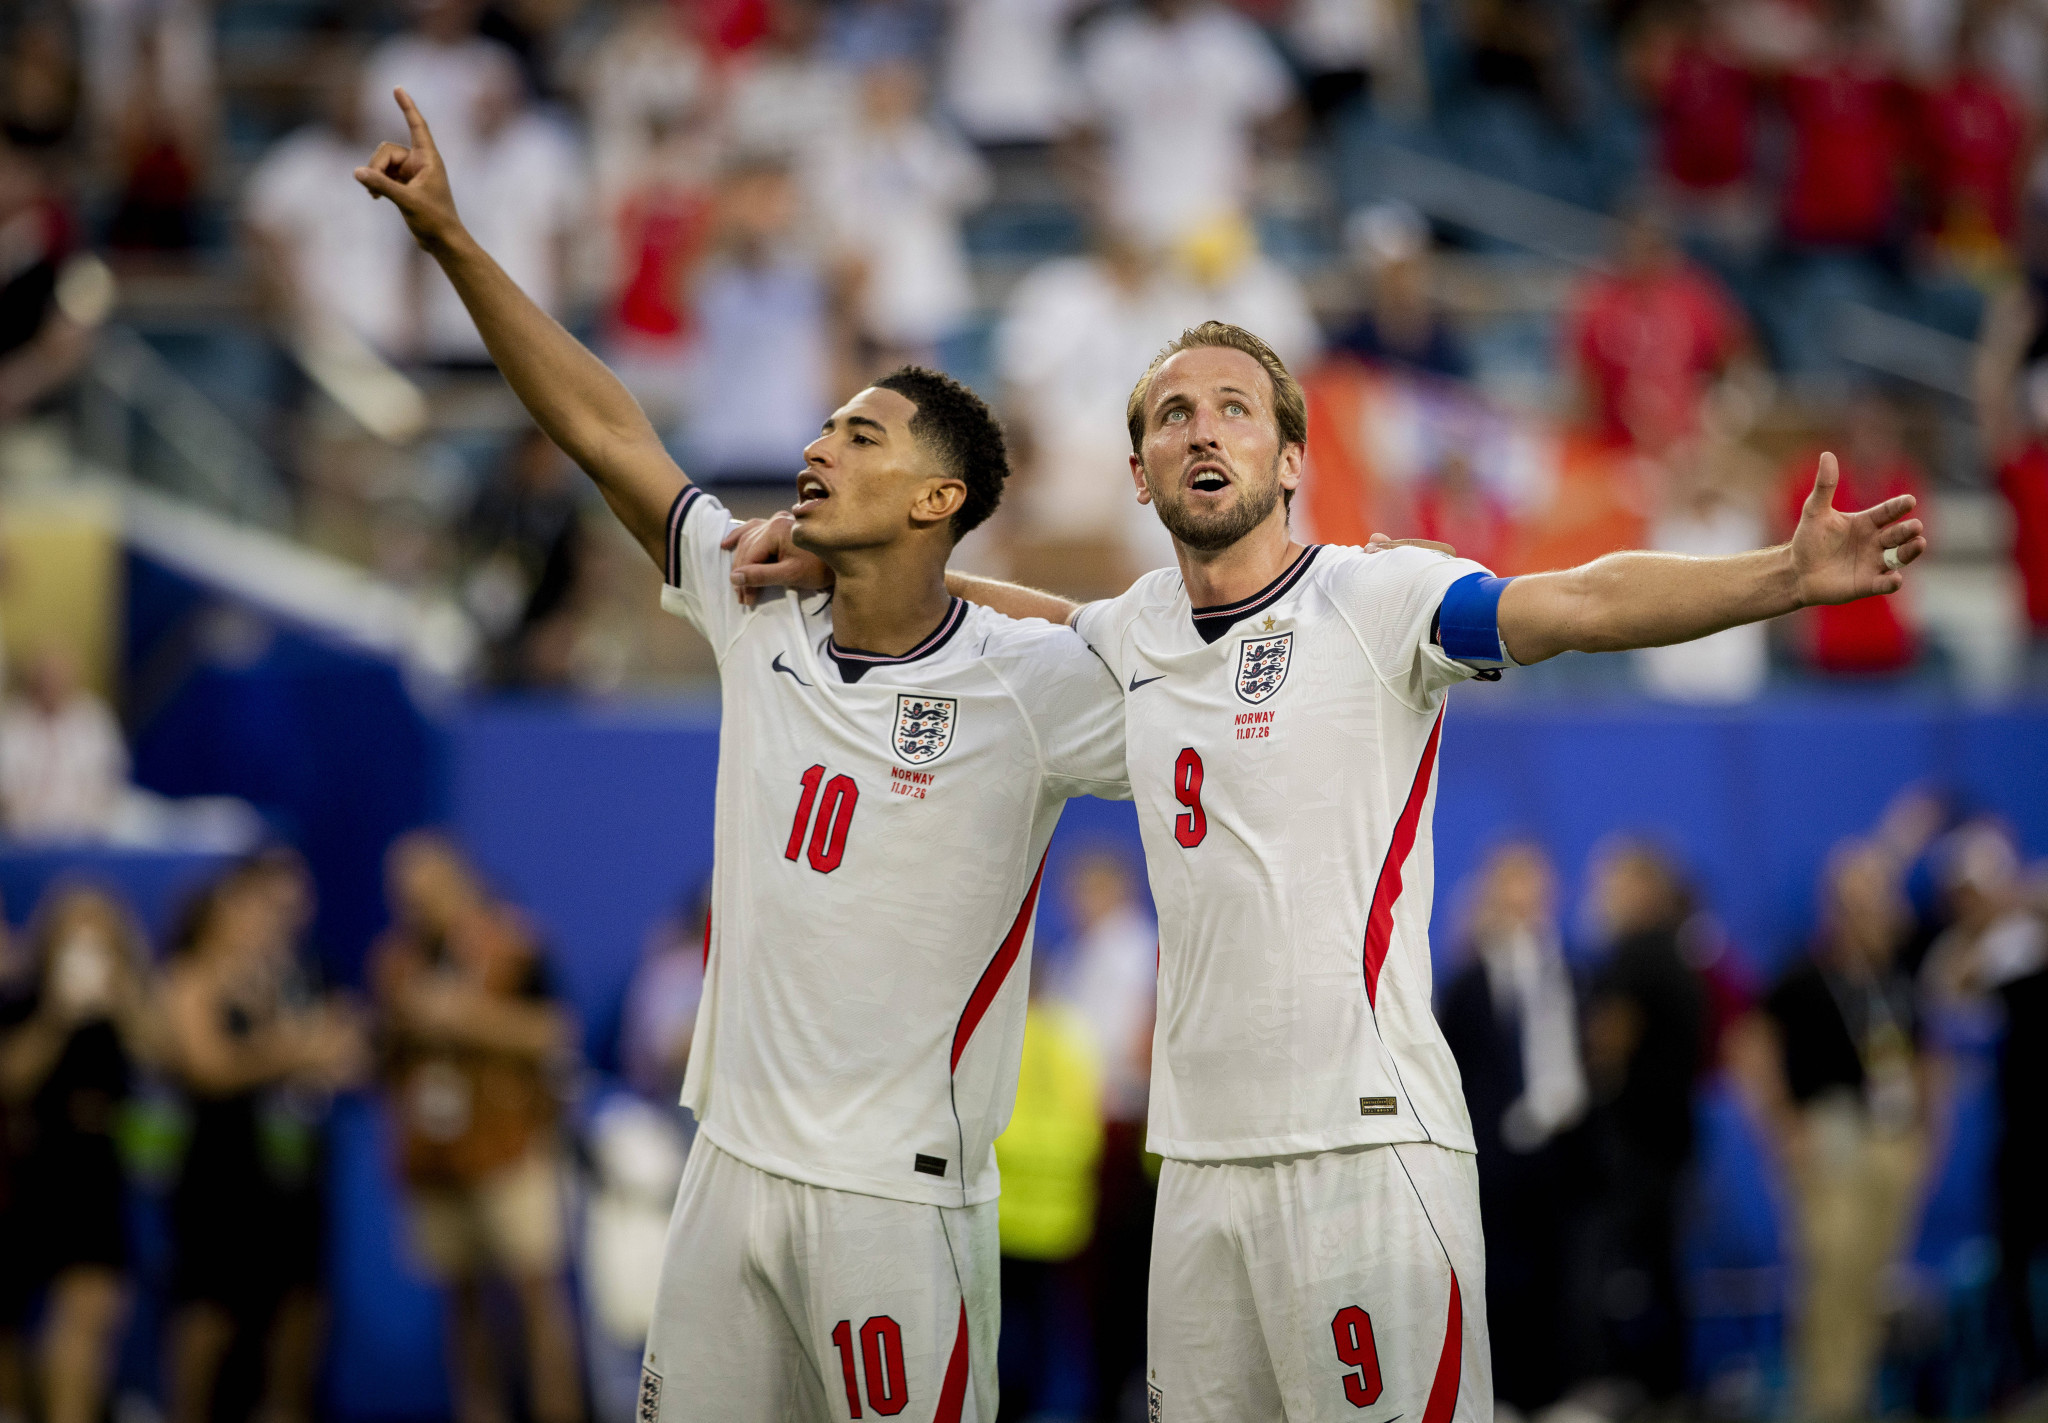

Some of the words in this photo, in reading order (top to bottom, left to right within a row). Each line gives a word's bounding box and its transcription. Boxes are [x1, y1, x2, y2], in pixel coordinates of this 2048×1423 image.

[1234, 711, 1275, 726] NORWAY
[1236, 726, 1270, 740] 11.07.26
[890, 781, 927, 799] 11.07.26
[891, 766, 935, 785] NORWAY
[1174, 747, 1207, 849] 9
[785, 764, 859, 874] 10
[832, 1315, 909, 1419] 10
[1331, 1305, 1383, 1408] 9
